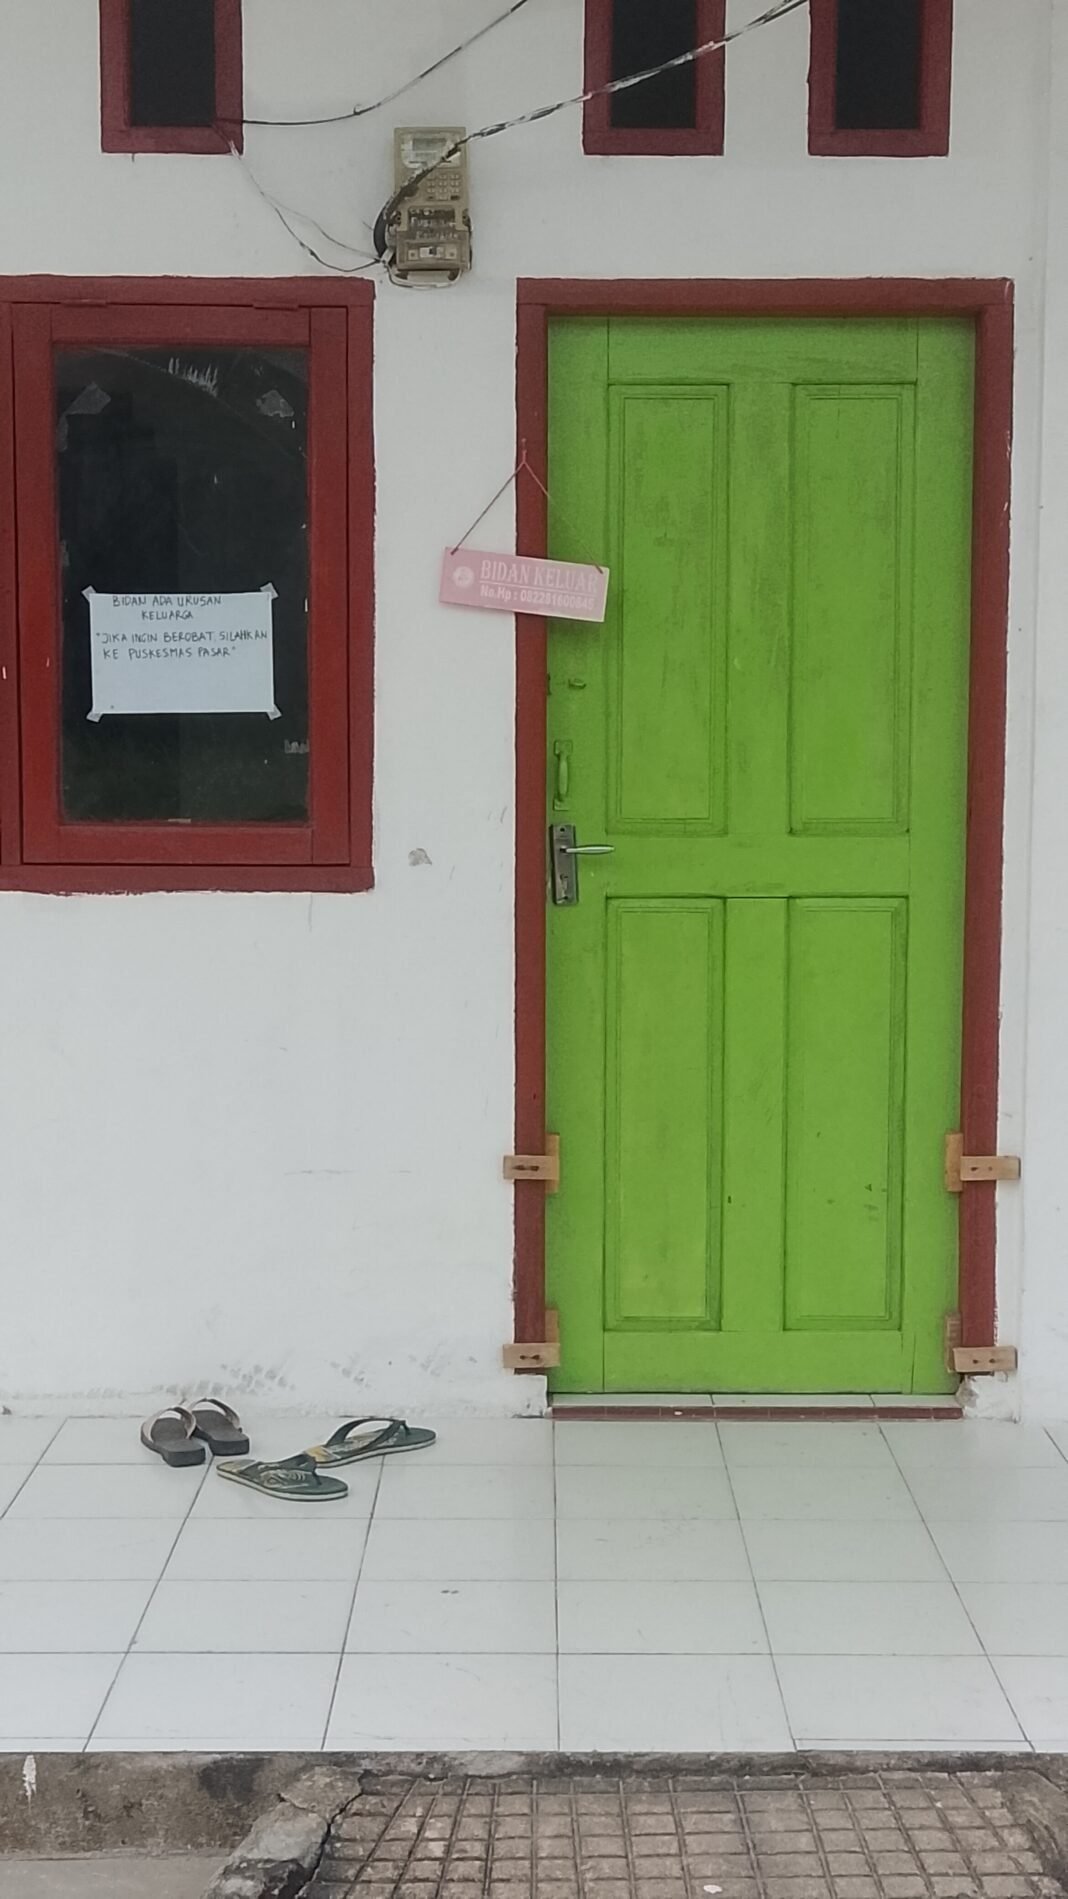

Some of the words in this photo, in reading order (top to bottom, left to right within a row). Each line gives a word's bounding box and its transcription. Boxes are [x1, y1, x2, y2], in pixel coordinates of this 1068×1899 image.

[481, 561, 530, 583] BIDAN
[534, 568, 599, 592] KELUAR
[112, 595, 147, 607] BIDAN
[152, 595, 173, 607] ADA
[177, 595, 222, 607] URUSAN
[142, 609, 194, 621] KELUARGA
[131, 632, 158, 644] INGIN
[219, 629, 268, 642] SILAHKAN
[103, 648, 119, 660] KE
[128, 647, 193, 661] PUSKESMAS
